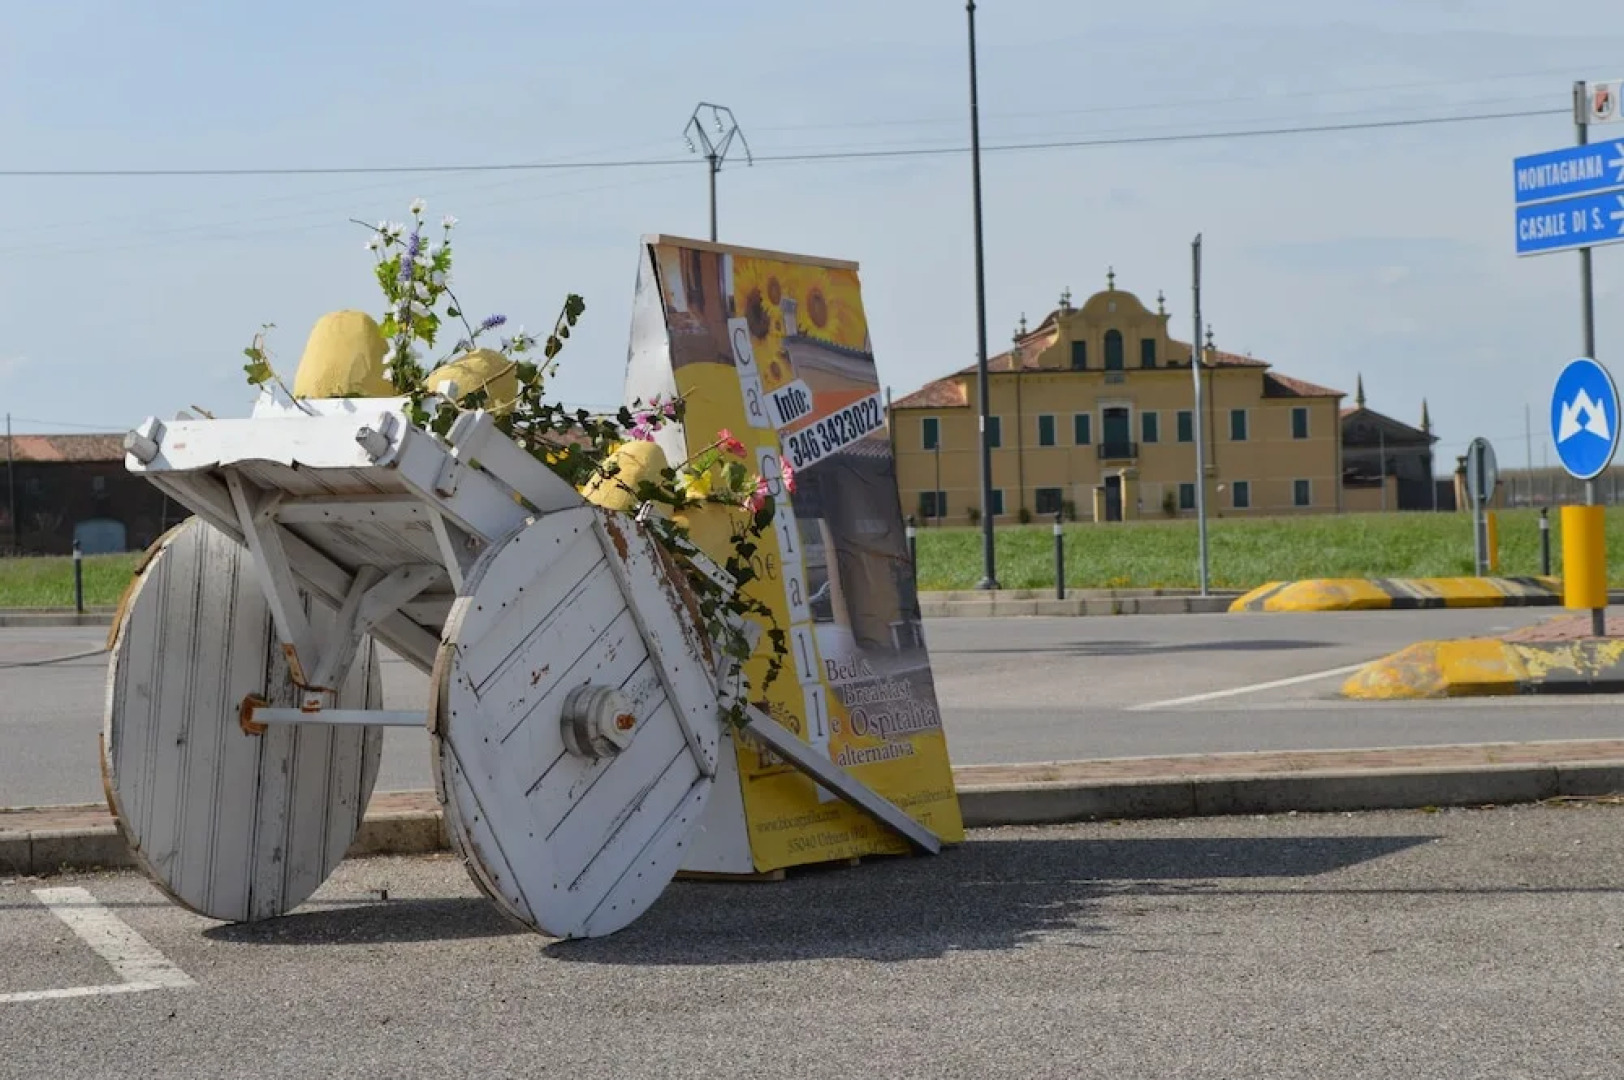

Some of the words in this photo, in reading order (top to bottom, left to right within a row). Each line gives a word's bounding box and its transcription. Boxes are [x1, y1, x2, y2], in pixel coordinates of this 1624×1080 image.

[1518, 155, 1603, 191] MONTAGNANA
[1520, 212, 1567, 241] CASALE
[1571, 209, 1587, 233] DI
[1592, 206, 1605, 230] S.
[773, 387, 811, 424] Info:
[788, 428, 821, 467] 346
[816, 397, 883, 453] 3423022
[825, 656, 857, 681] Bed
[861, 659, 873, 677] &
[843, 678, 911, 705] Breakfast
[831, 718, 840, 733] e
[838, 743, 914, 767] alternativa
